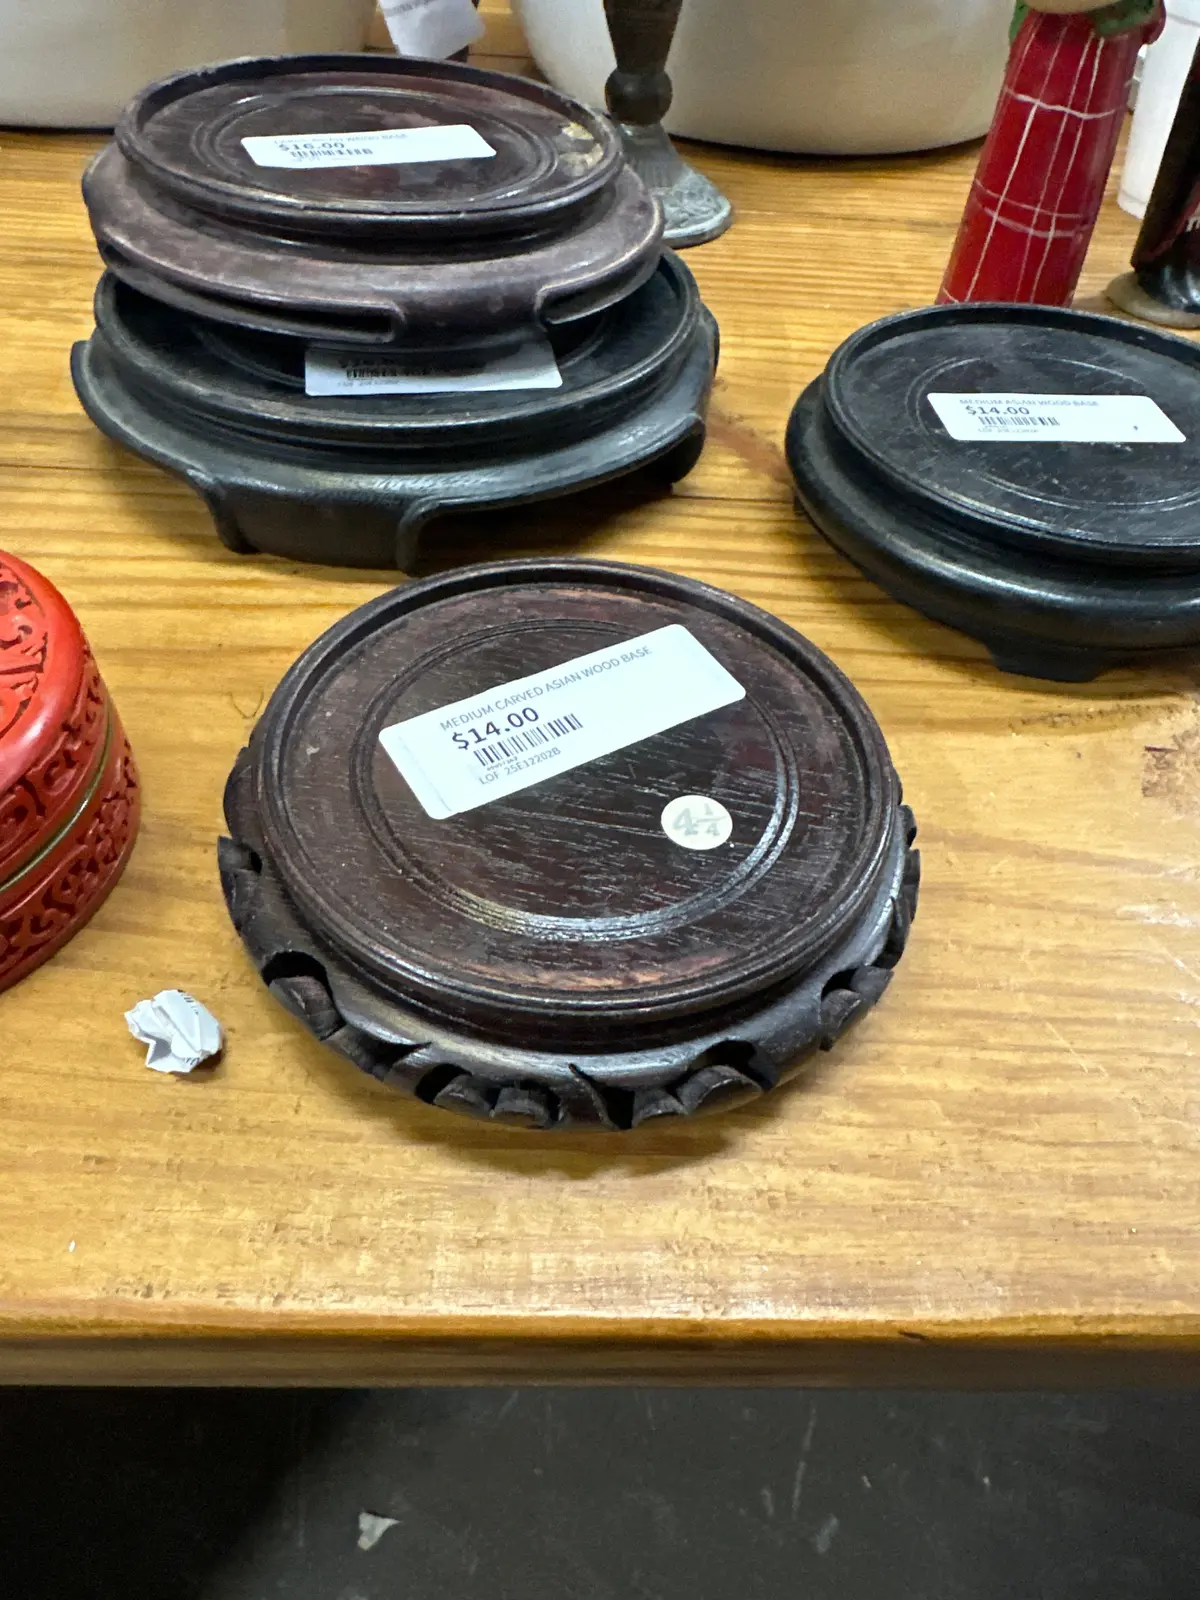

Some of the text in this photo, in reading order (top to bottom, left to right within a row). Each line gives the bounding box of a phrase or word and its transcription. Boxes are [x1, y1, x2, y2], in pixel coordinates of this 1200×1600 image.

[279, 142, 346, 152] $16.00
[965, 405, 1031, 416] $14.00
[440, 645, 653, 733] MEDIUM CARVED ASIAN WOOD BASE
[451, 706, 540, 751] $14.00
[478, 771, 501, 786] LOF
[504, 746, 562, 776] 25E12202B
